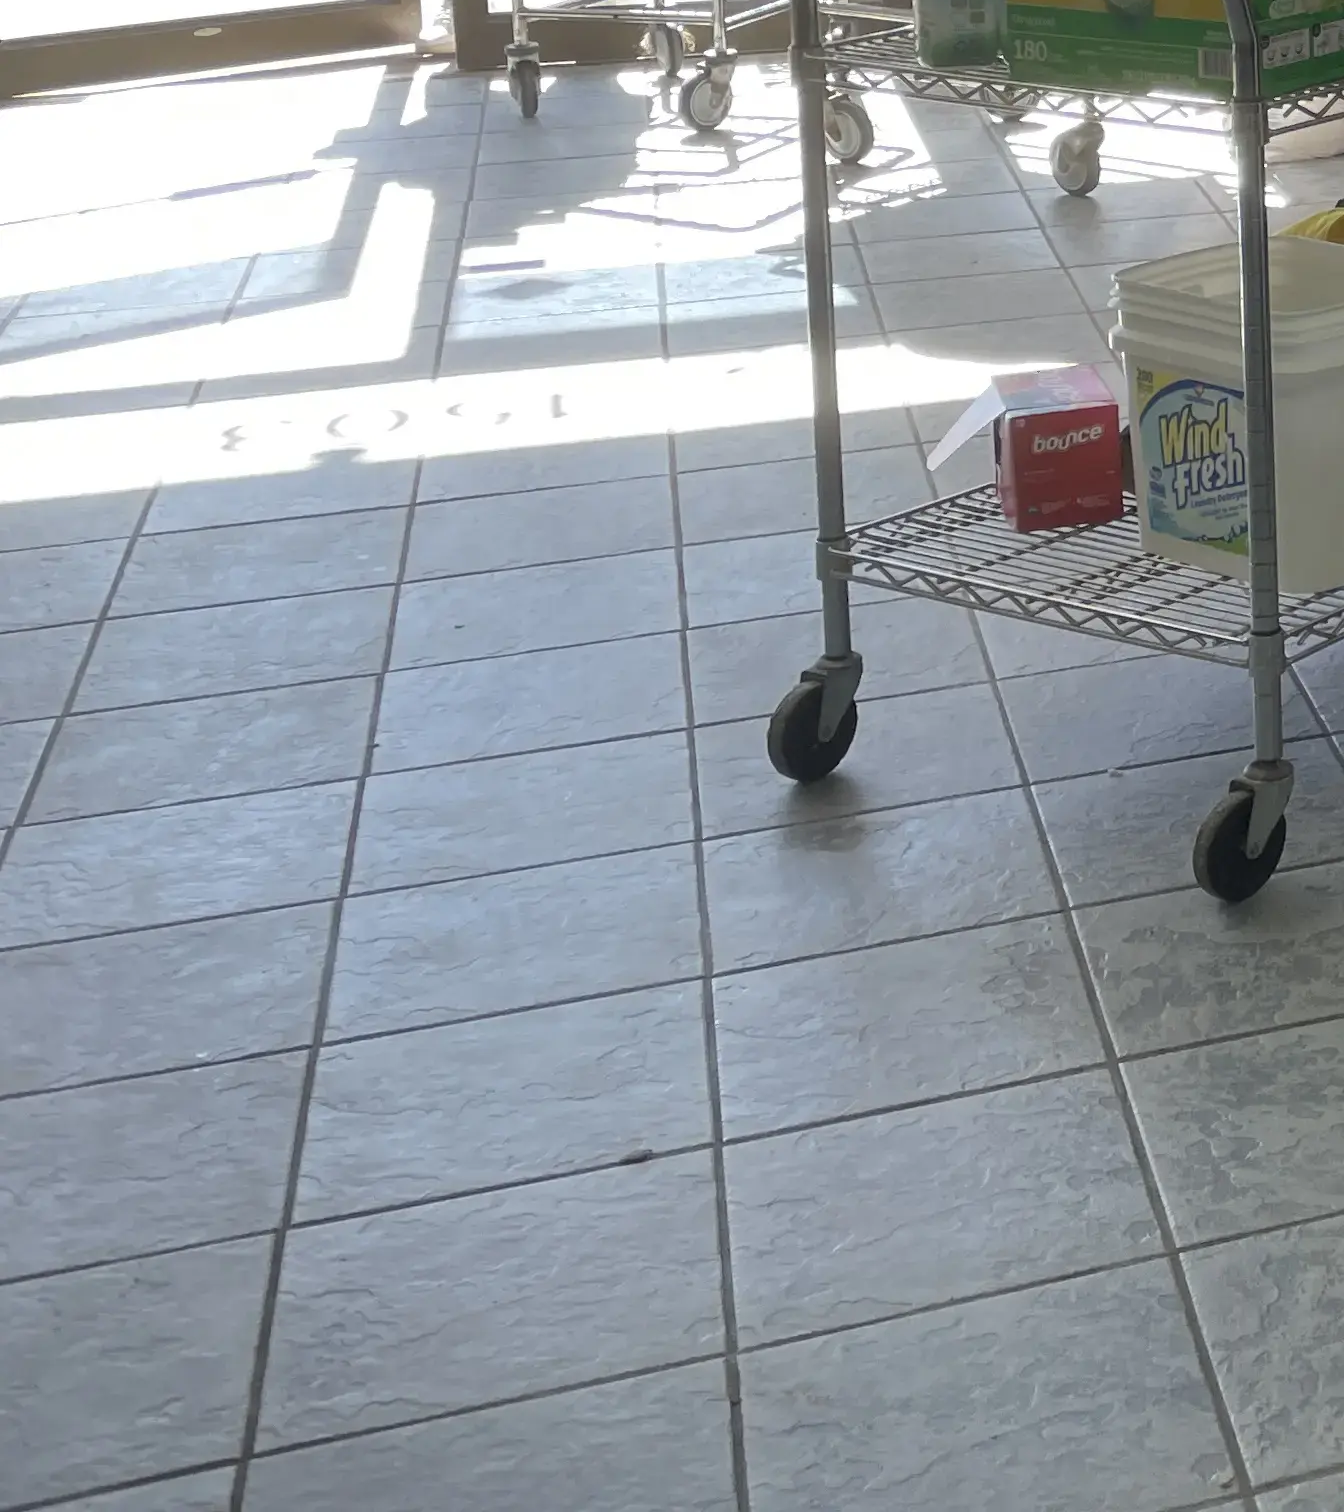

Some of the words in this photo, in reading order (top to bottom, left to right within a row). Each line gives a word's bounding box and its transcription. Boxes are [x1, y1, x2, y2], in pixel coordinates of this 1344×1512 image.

[1012, 38, 1048, 62] 180
[1033, 425, 1104, 454] bounce
[1159, 398, 1229, 468] Wind
[1174, 433, 1245, 510] Fresh
